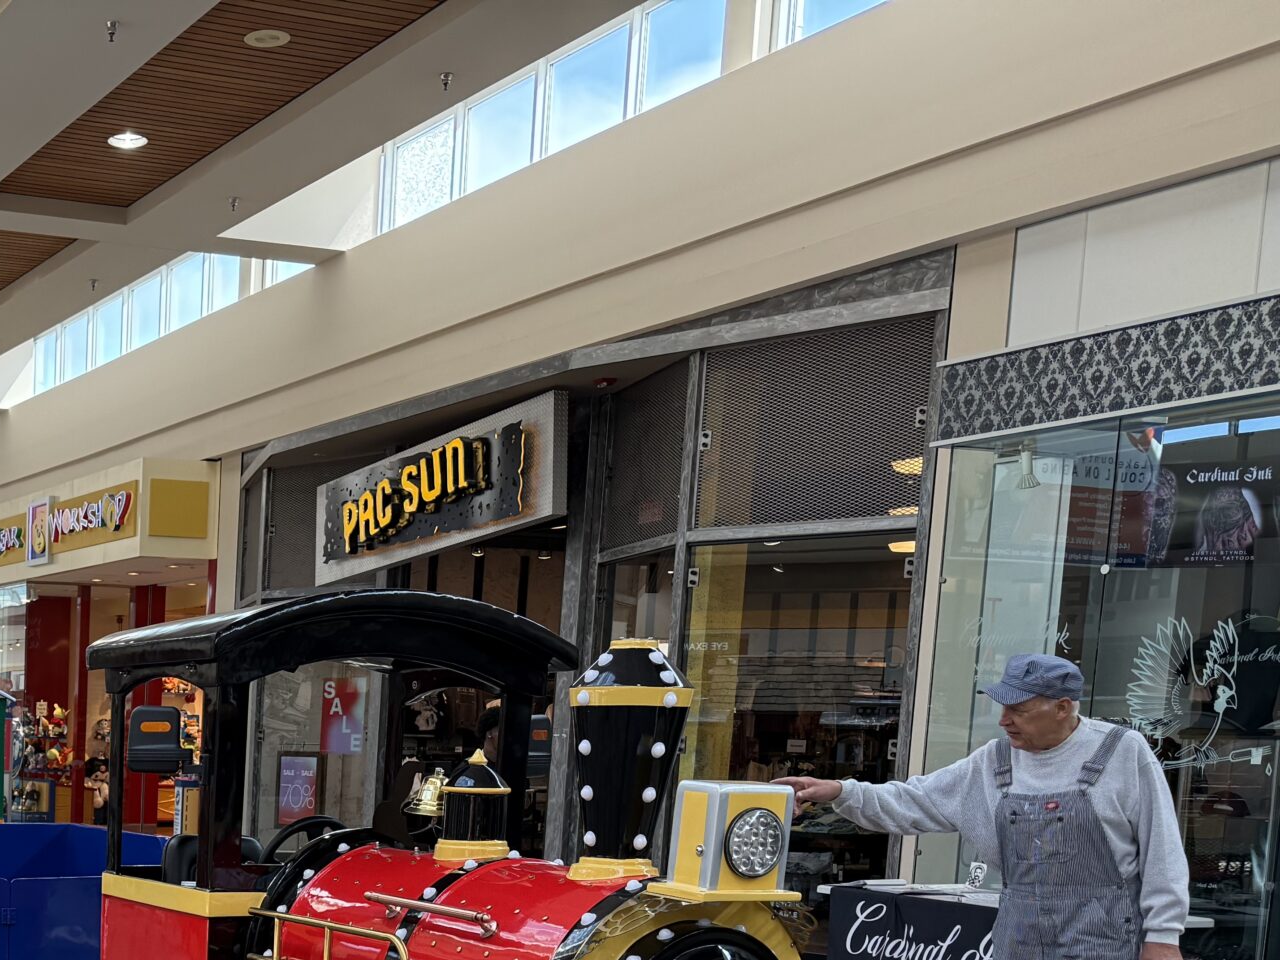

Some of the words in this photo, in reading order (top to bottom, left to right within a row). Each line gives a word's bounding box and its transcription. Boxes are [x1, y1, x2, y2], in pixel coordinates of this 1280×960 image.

[1186, 467, 1242, 484] Cardinal
[342, 478, 393, 554] PAC
[401, 437, 469, 514] SUN
[48, 490, 133, 544] WORKSHOP
[280, 784, 316, 809] 70%
